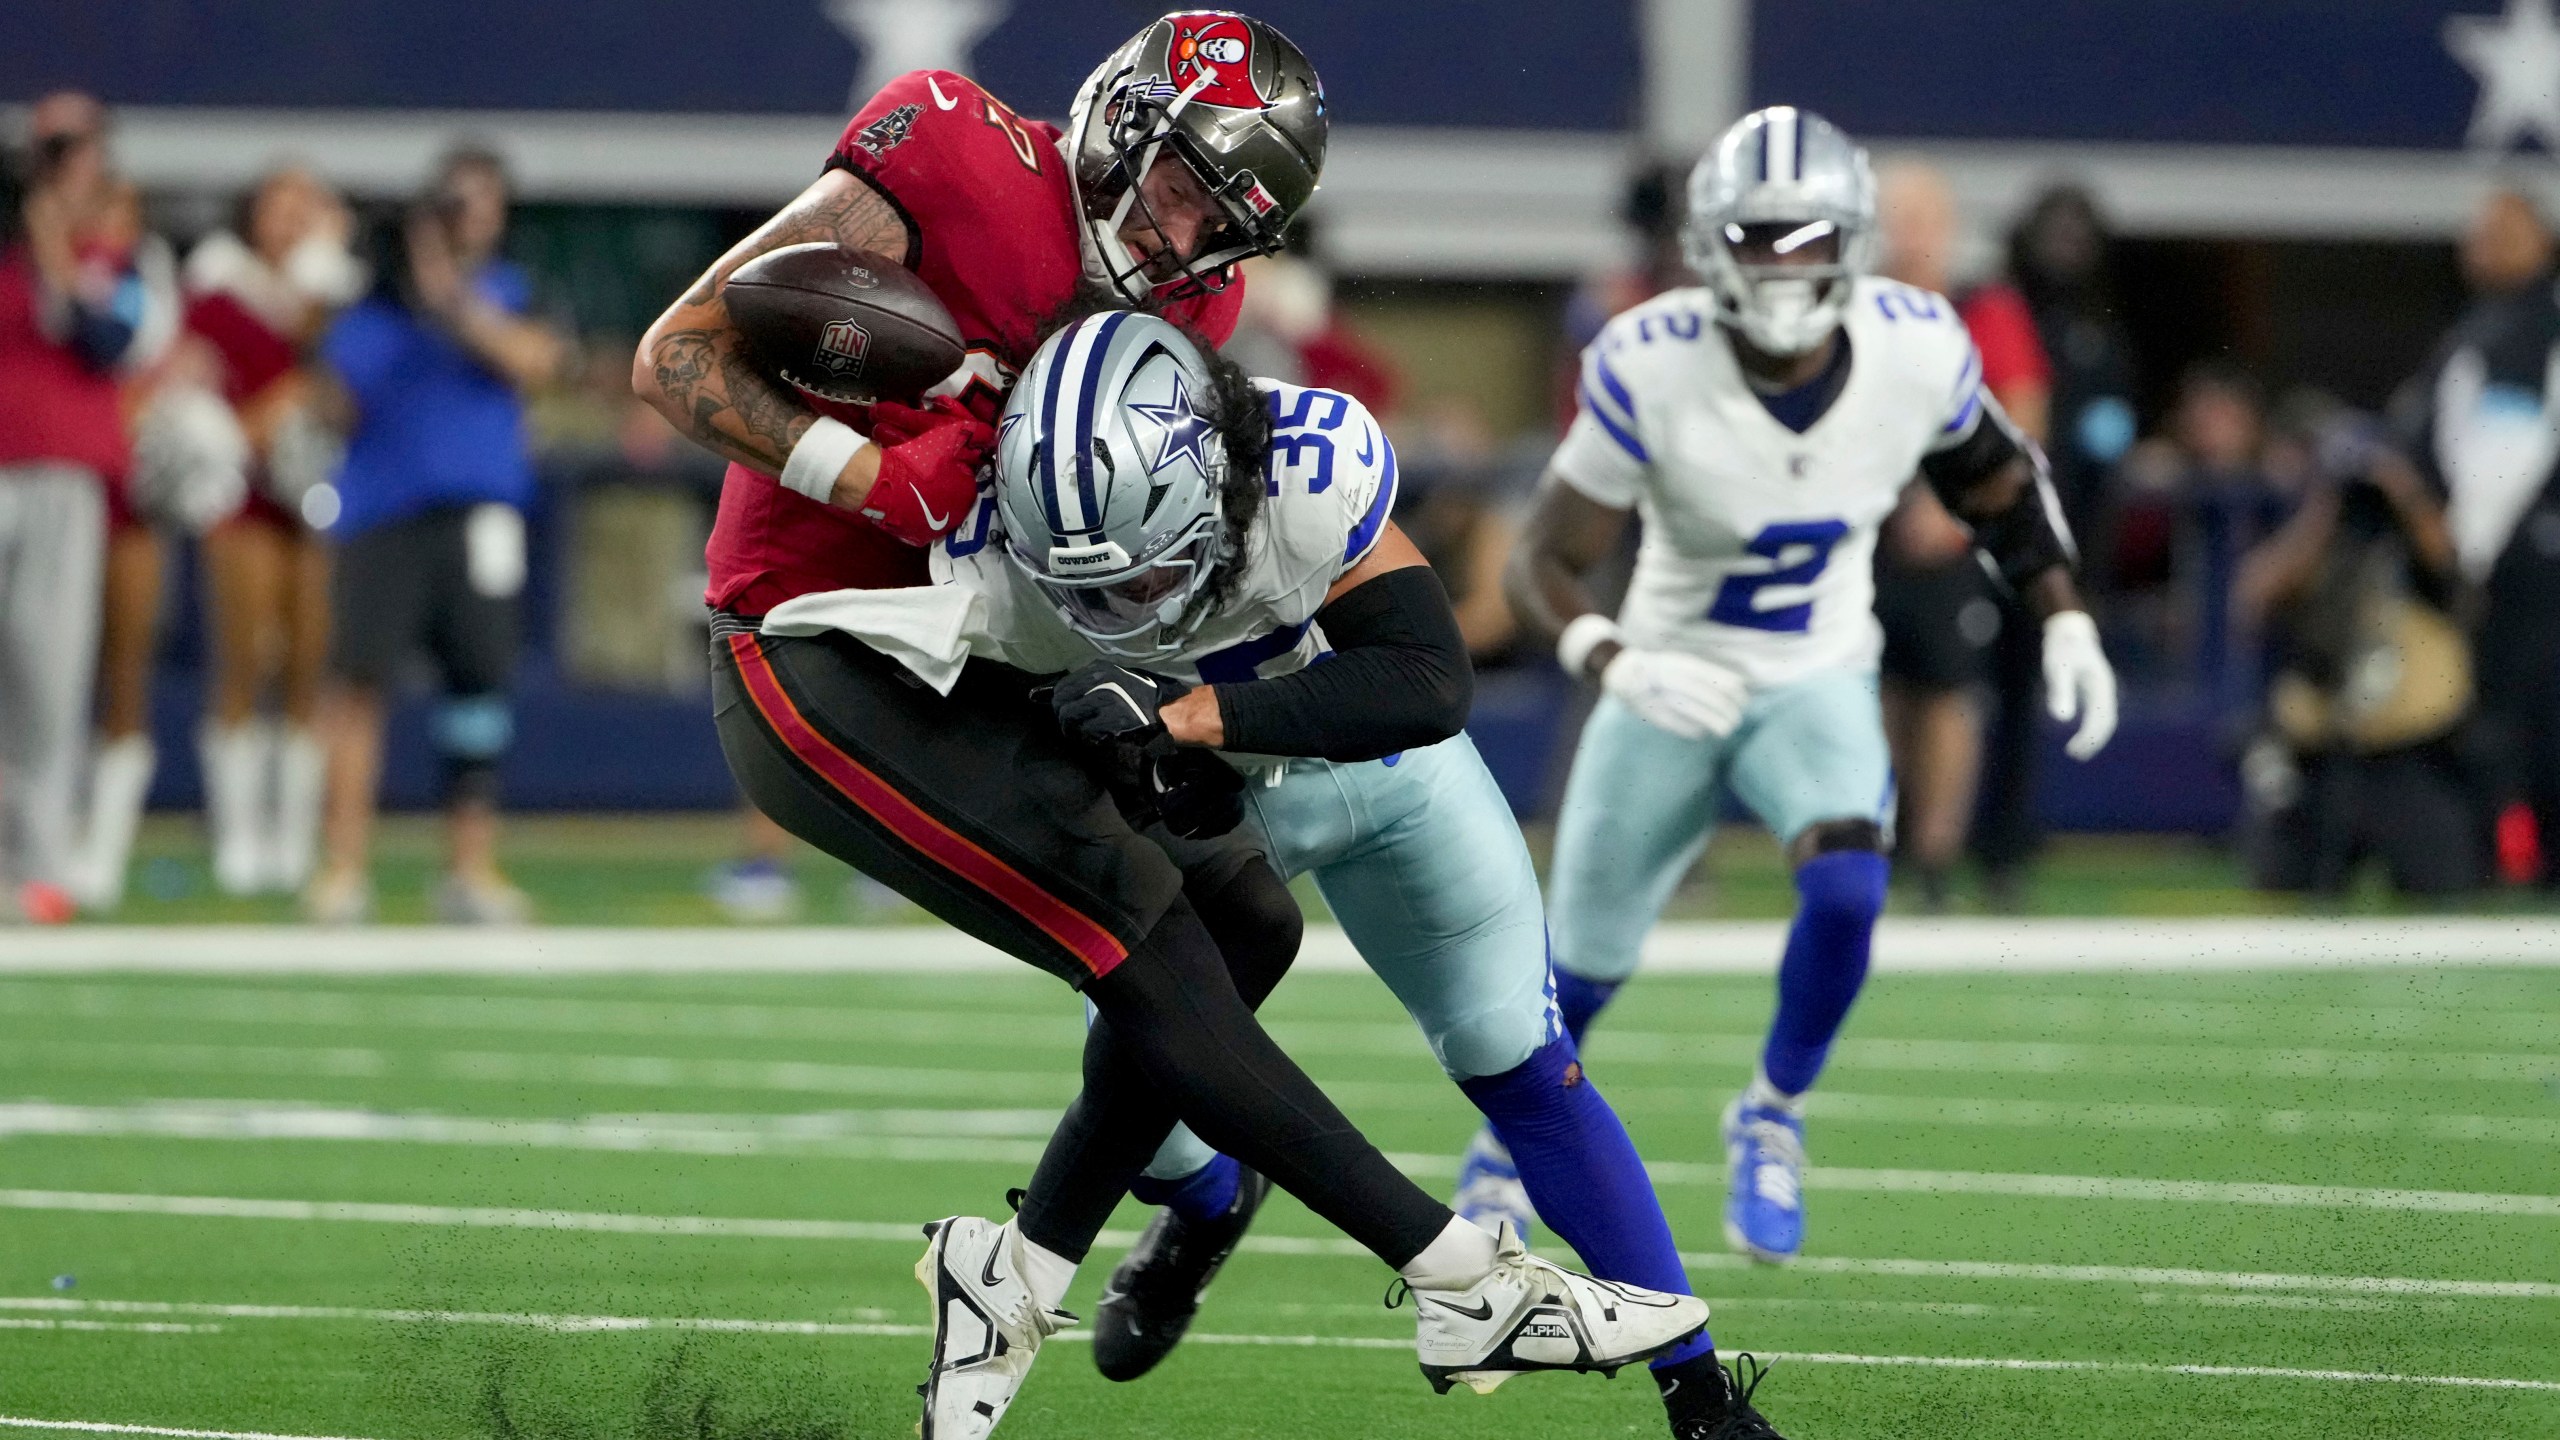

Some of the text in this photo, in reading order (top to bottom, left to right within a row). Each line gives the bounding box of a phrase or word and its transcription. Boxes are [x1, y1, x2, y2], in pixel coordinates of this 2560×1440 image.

[851, 266, 870, 279] 158
[828, 327, 866, 358] NFL
[1265, 389, 1349, 498] 35
[1057, 551, 1111, 566] COWBOYS
[1706, 517, 1849, 632] 2
[1518, 1324, 1570, 1338] ALPHA
